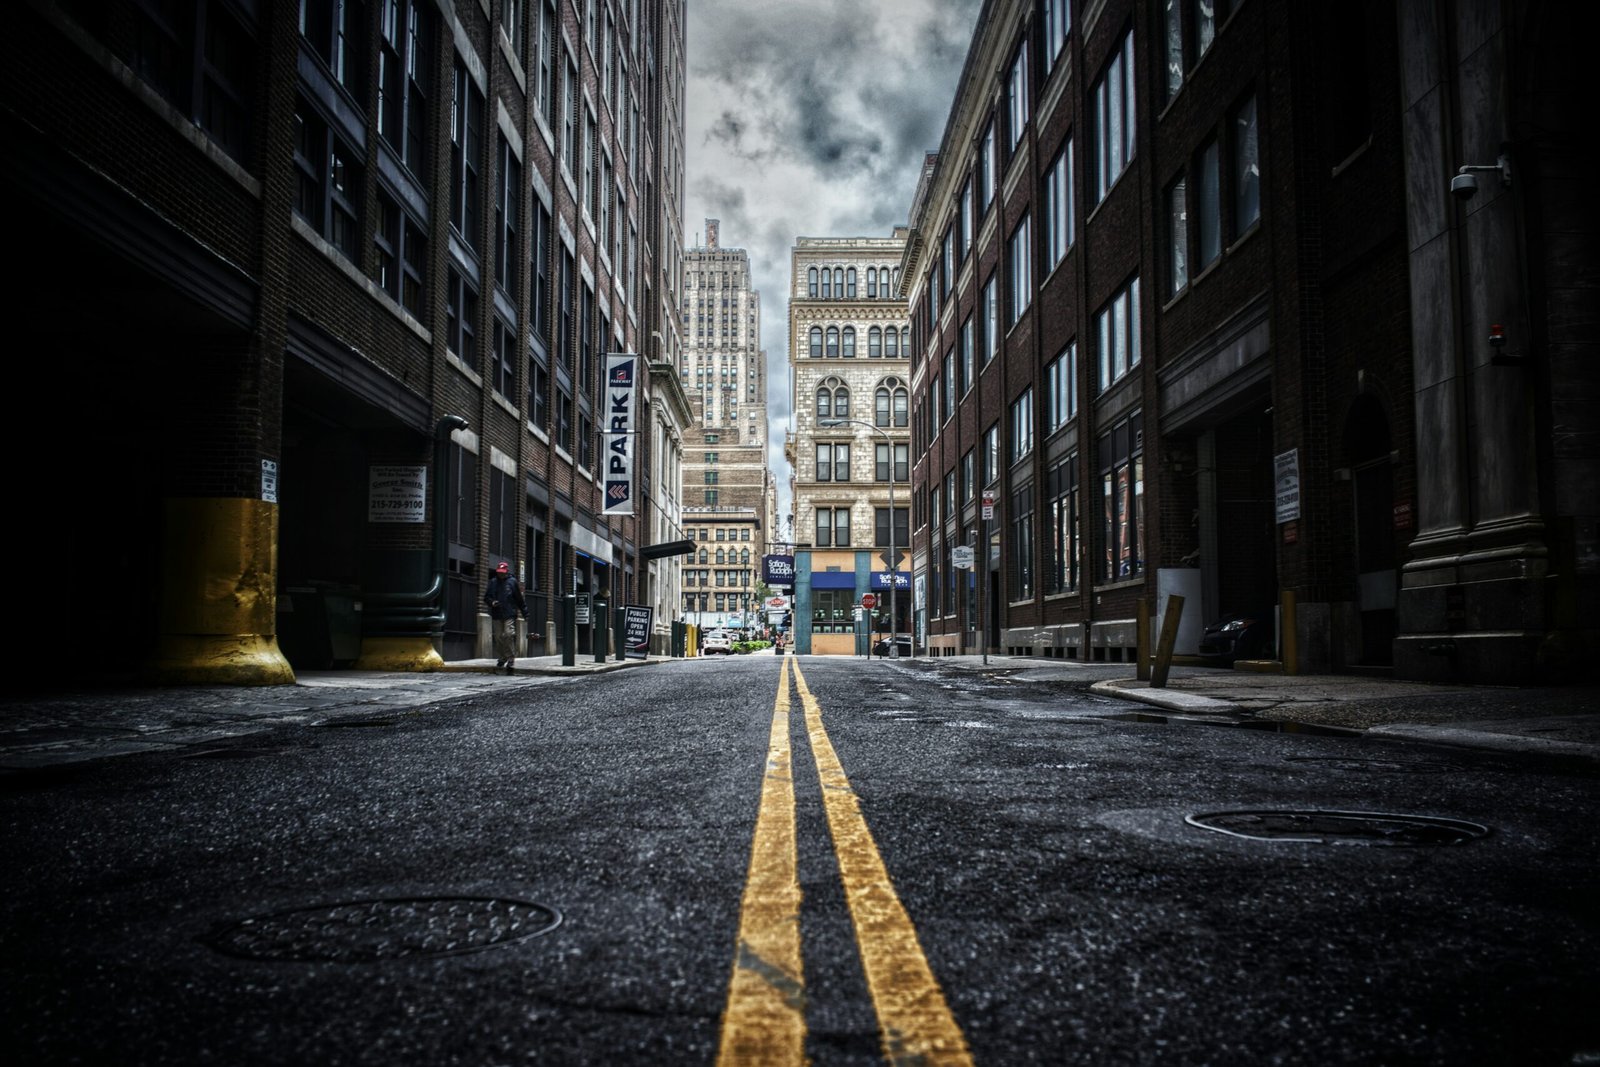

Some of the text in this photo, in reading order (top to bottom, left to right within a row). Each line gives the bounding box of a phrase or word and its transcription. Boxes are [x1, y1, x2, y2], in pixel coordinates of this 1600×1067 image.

[610, 392, 628, 474] PARK
[372, 500, 423, 509] 215-729-9100
[770, 567, 792, 576] Rudolph
